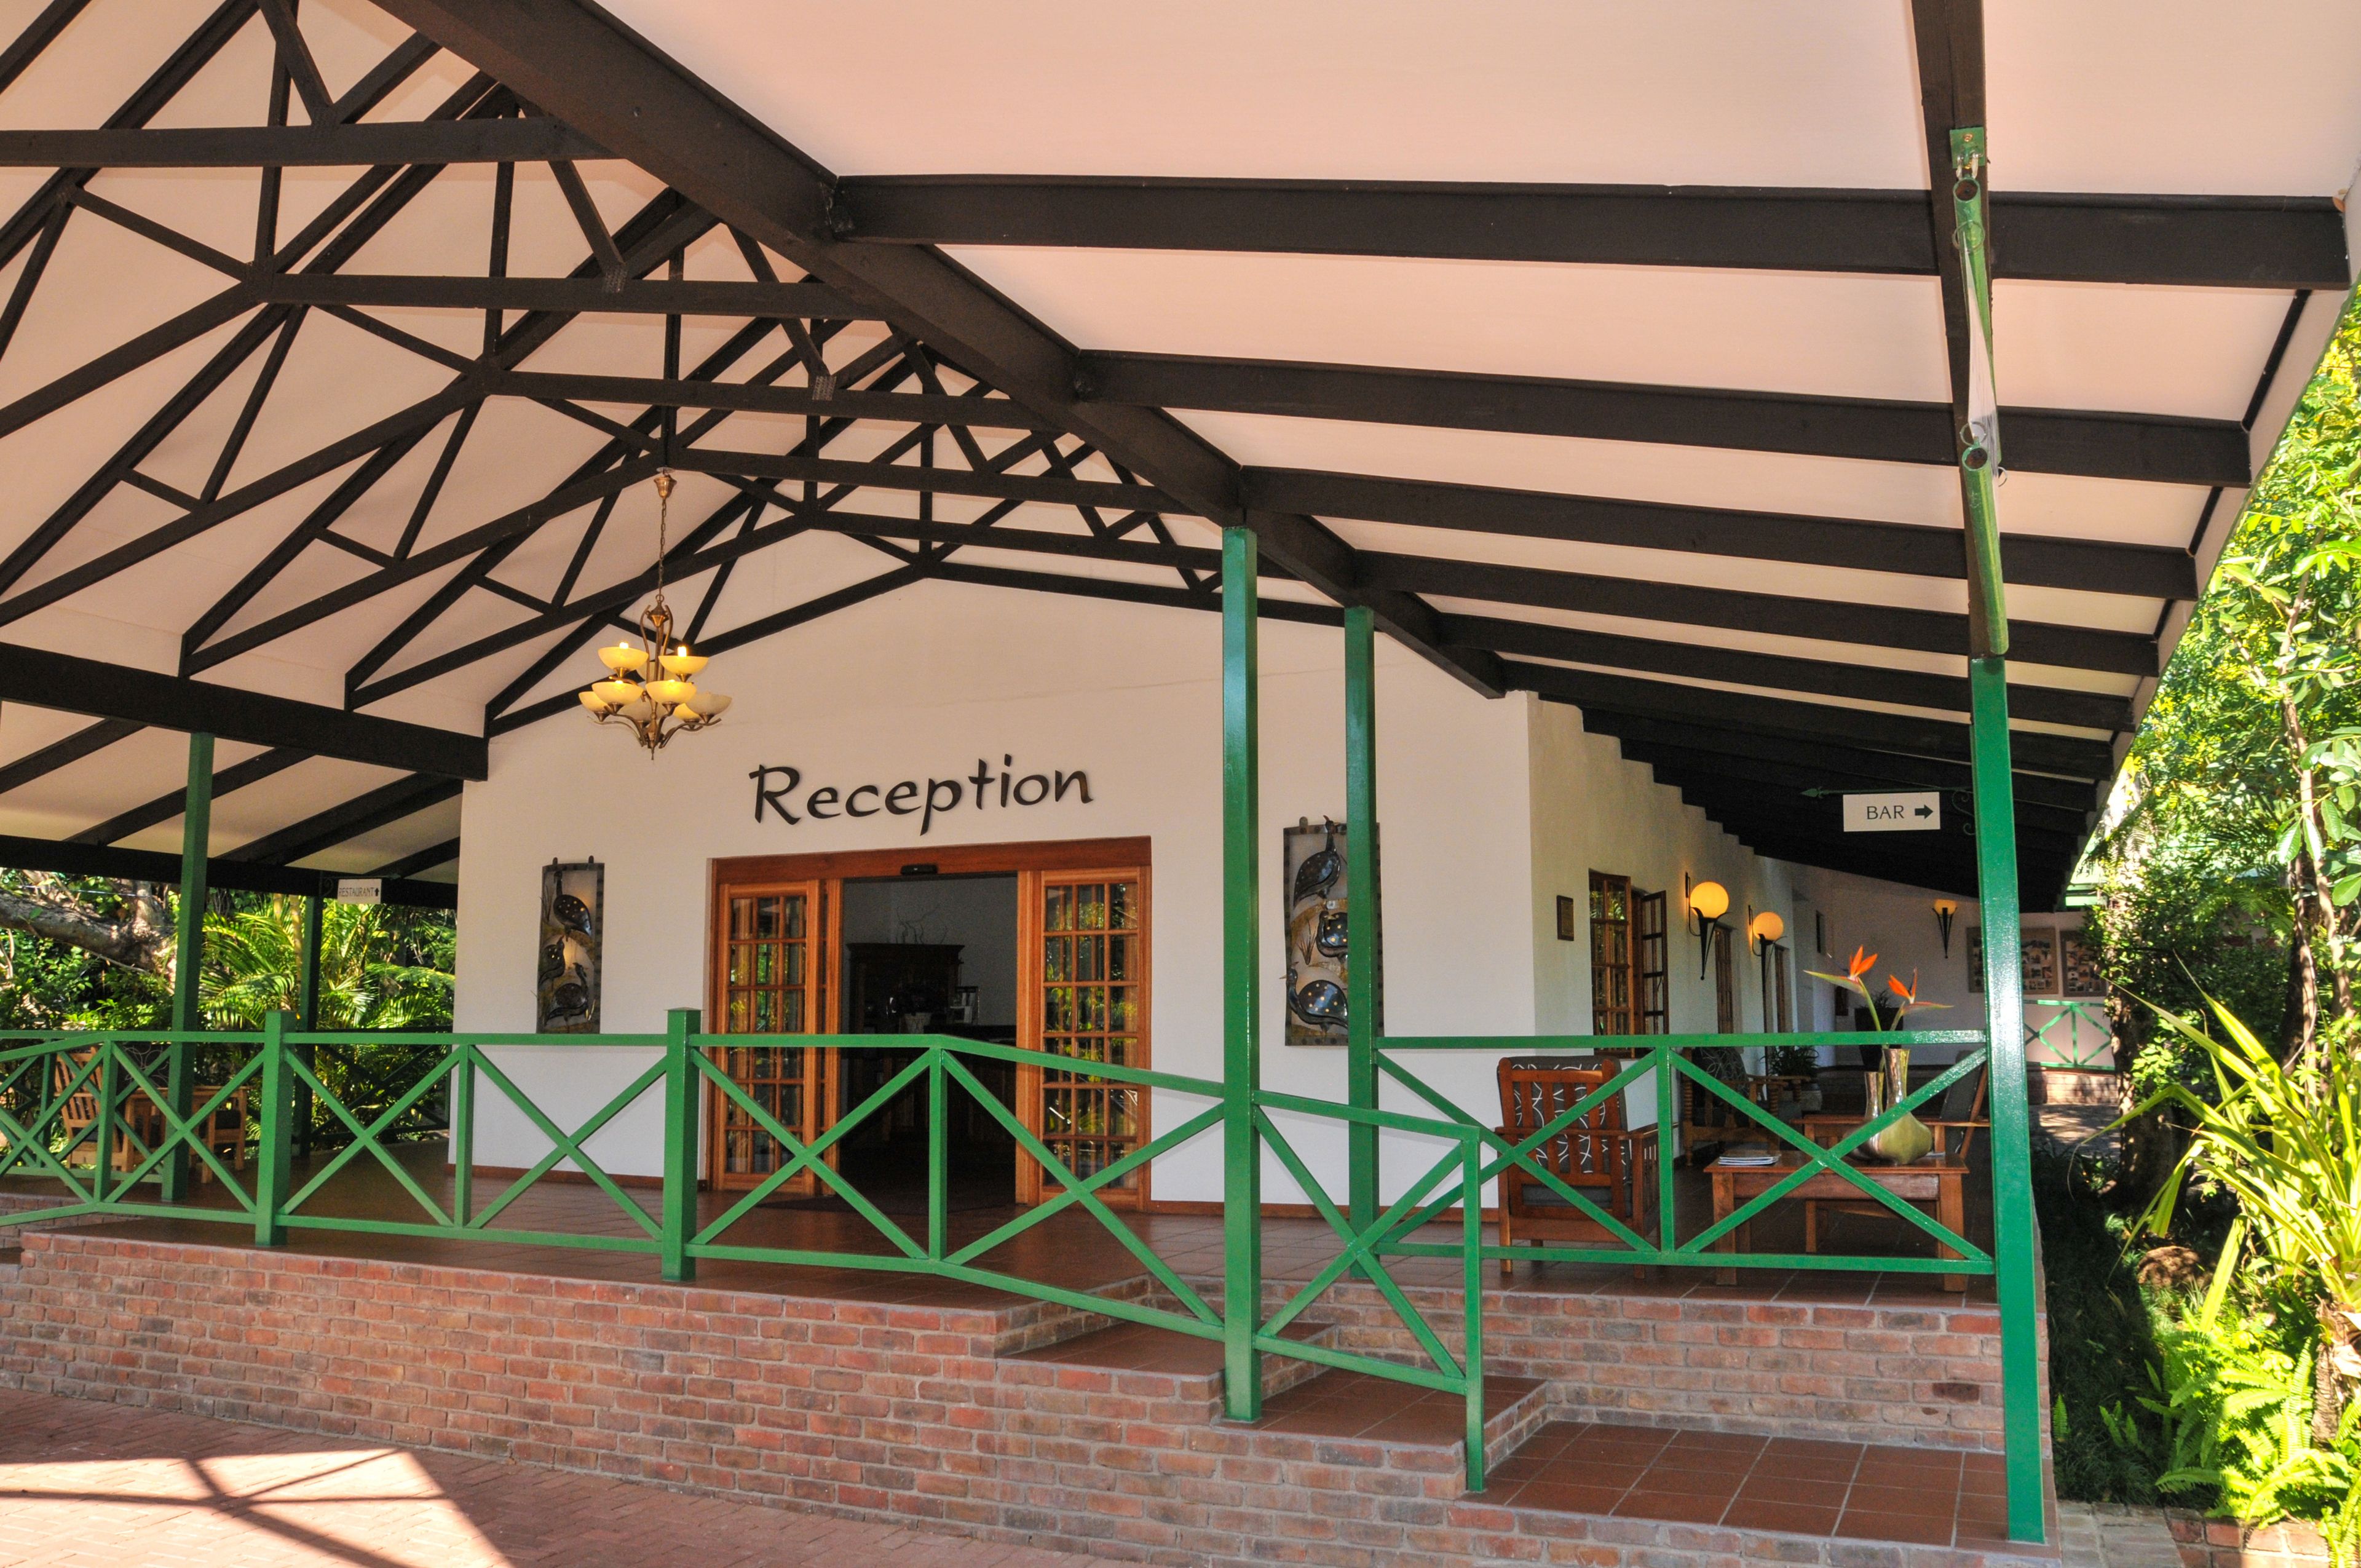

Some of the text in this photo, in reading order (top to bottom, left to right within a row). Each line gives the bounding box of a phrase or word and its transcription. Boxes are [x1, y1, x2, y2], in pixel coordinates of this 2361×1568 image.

[748, 753, 1094, 836] Reception
[1867, 805, 1905, 820] BAR
[339, 887, 374, 897] RESTAURANT
